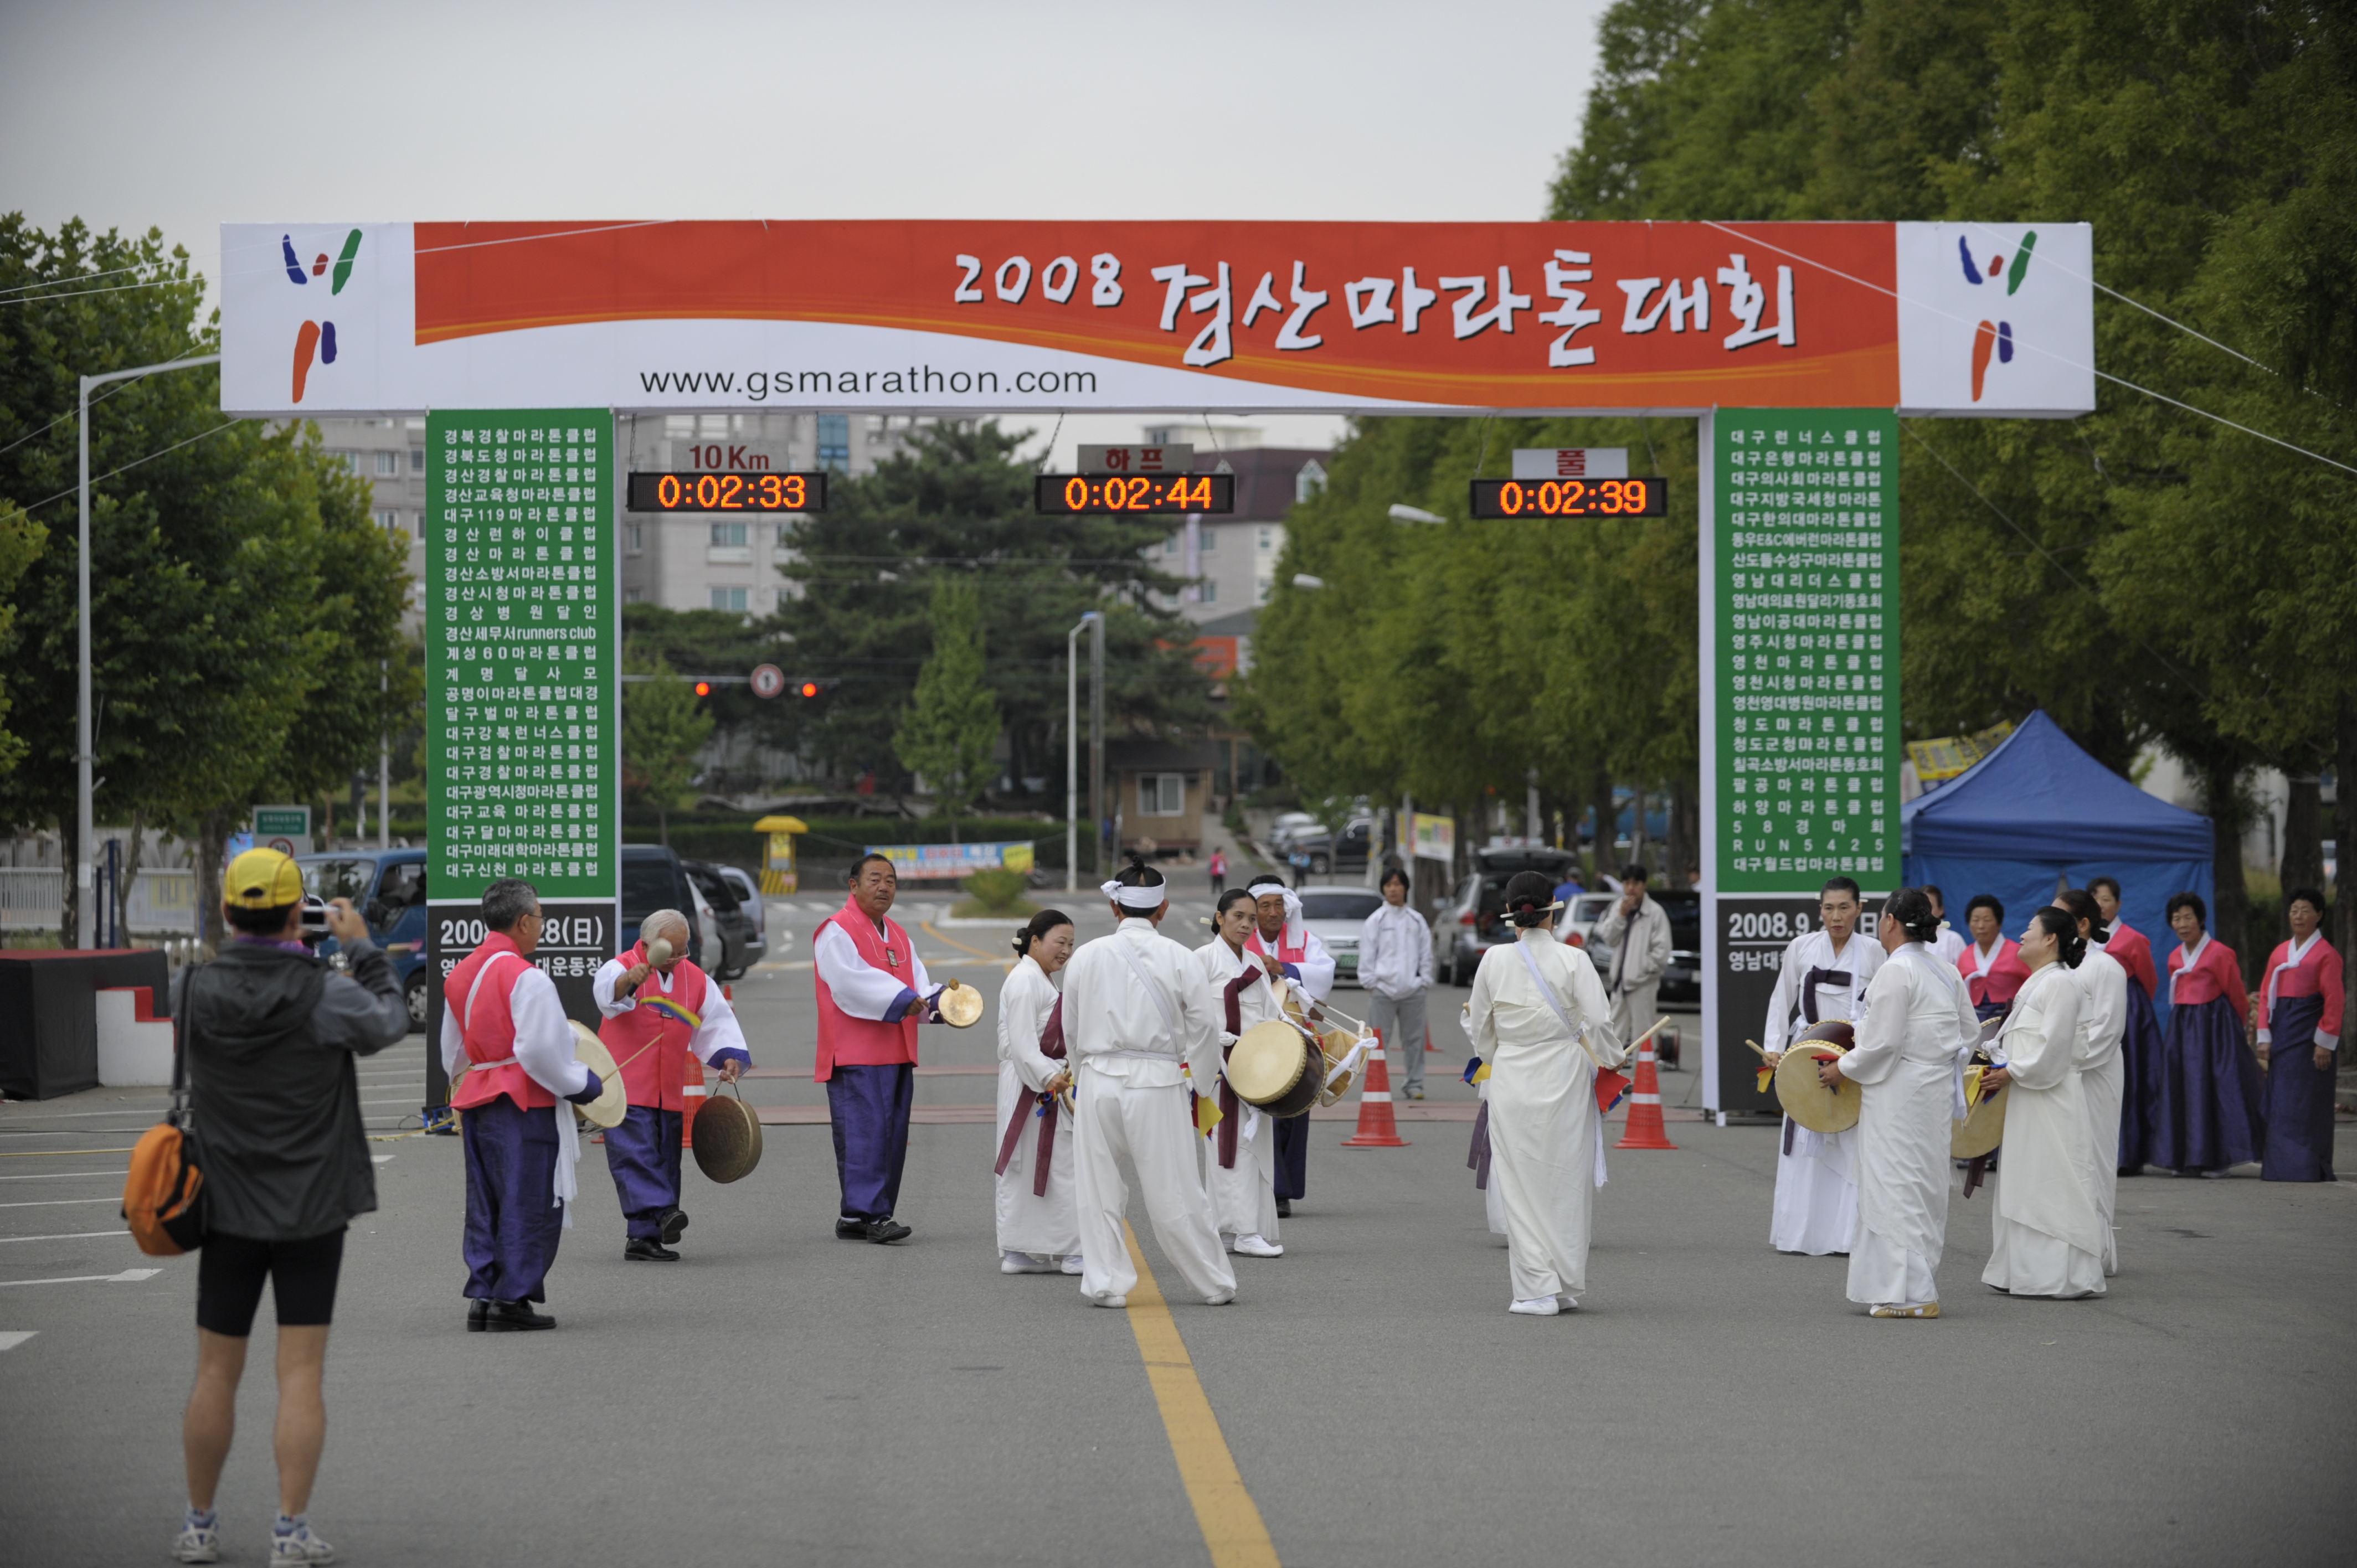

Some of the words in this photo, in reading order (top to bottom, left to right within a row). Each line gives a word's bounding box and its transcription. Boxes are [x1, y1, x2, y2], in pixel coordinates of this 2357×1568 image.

[954, 252, 1124, 307] 2008
[641, 365, 1097, 401] www.gsmarathon.com
[1105, 448, 1163, 471] 하프
[658, 475, 805, 508] 0:02:33
[1065, 477, 1212, 510] 0:02:44
[1500, 481, 1646, 514] 0:02:39
[569, 626, 596, 640] club
